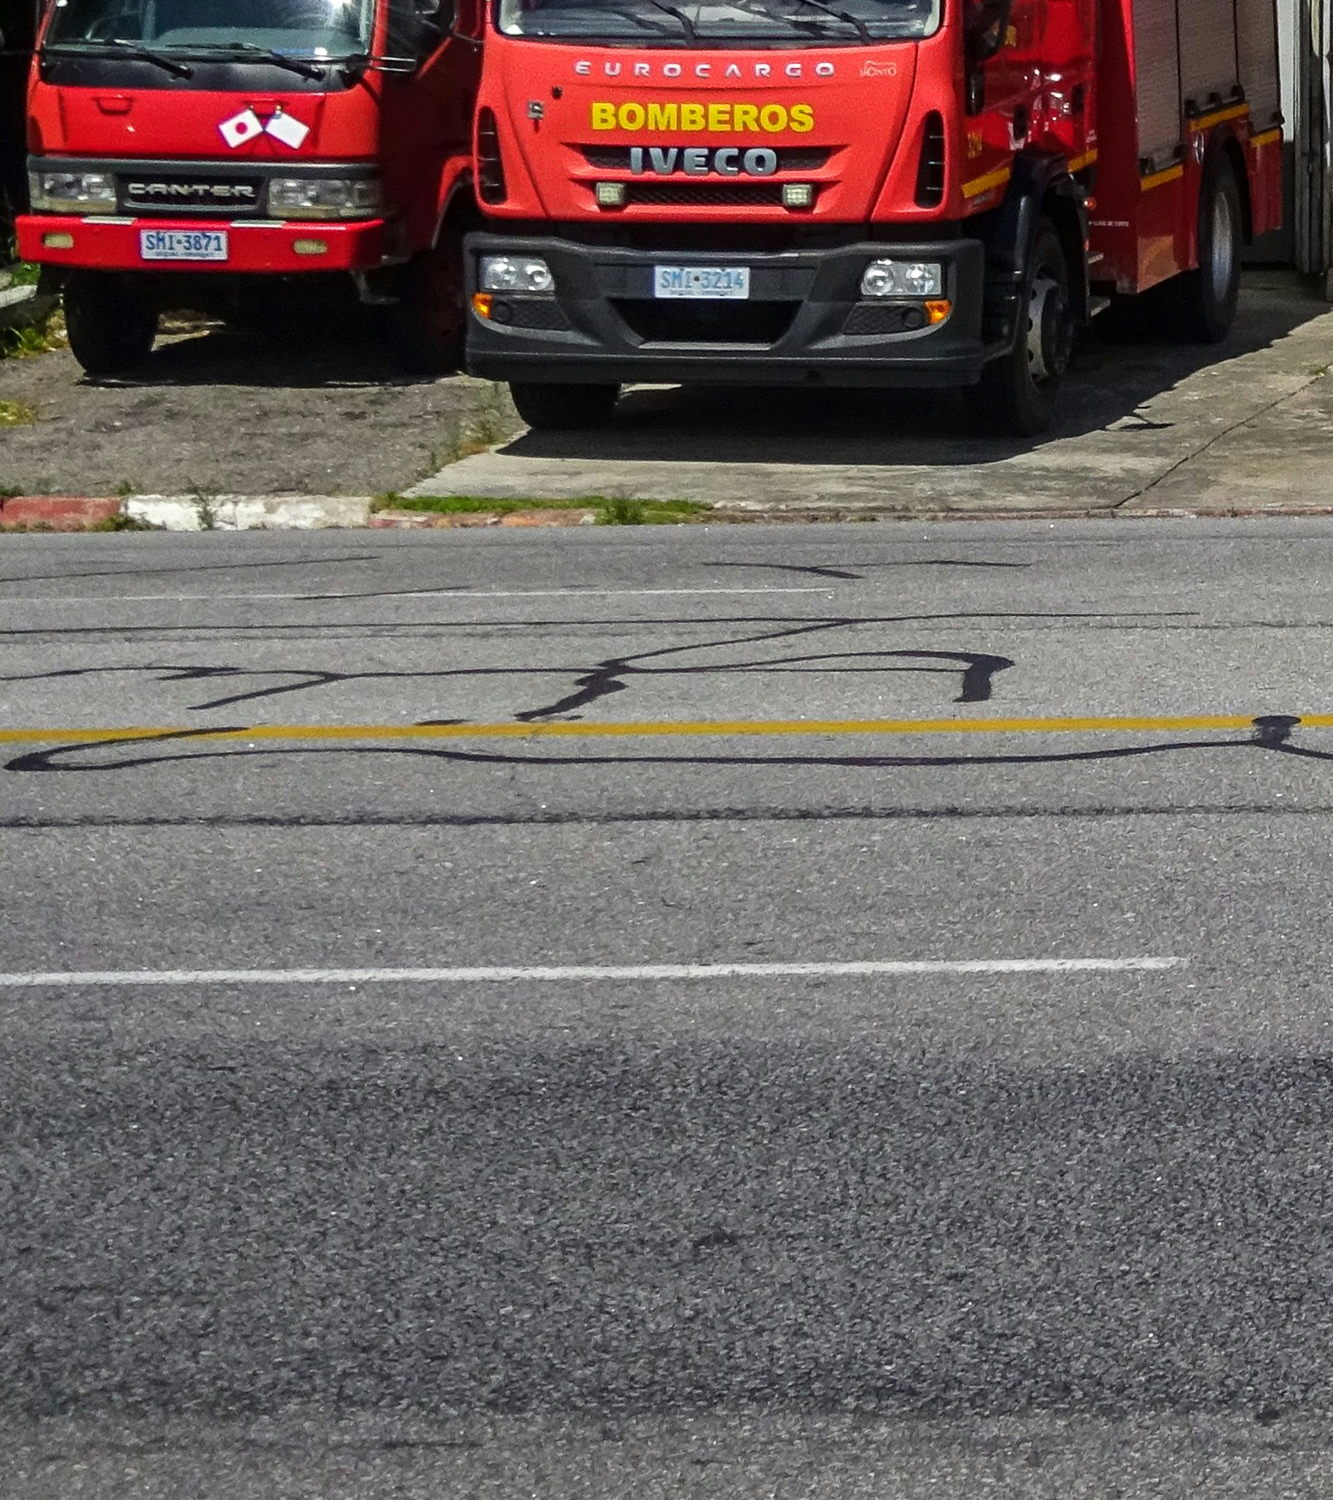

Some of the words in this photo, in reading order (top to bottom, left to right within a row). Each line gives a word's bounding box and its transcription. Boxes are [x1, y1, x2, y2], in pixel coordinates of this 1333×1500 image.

[575, 61, 835, 78] EUROCARGO
[592, 102, 815, 132] BOMBEROS
[630, 147, 778, 176] IVECO
[128, 183, 256, 197] CANTER
